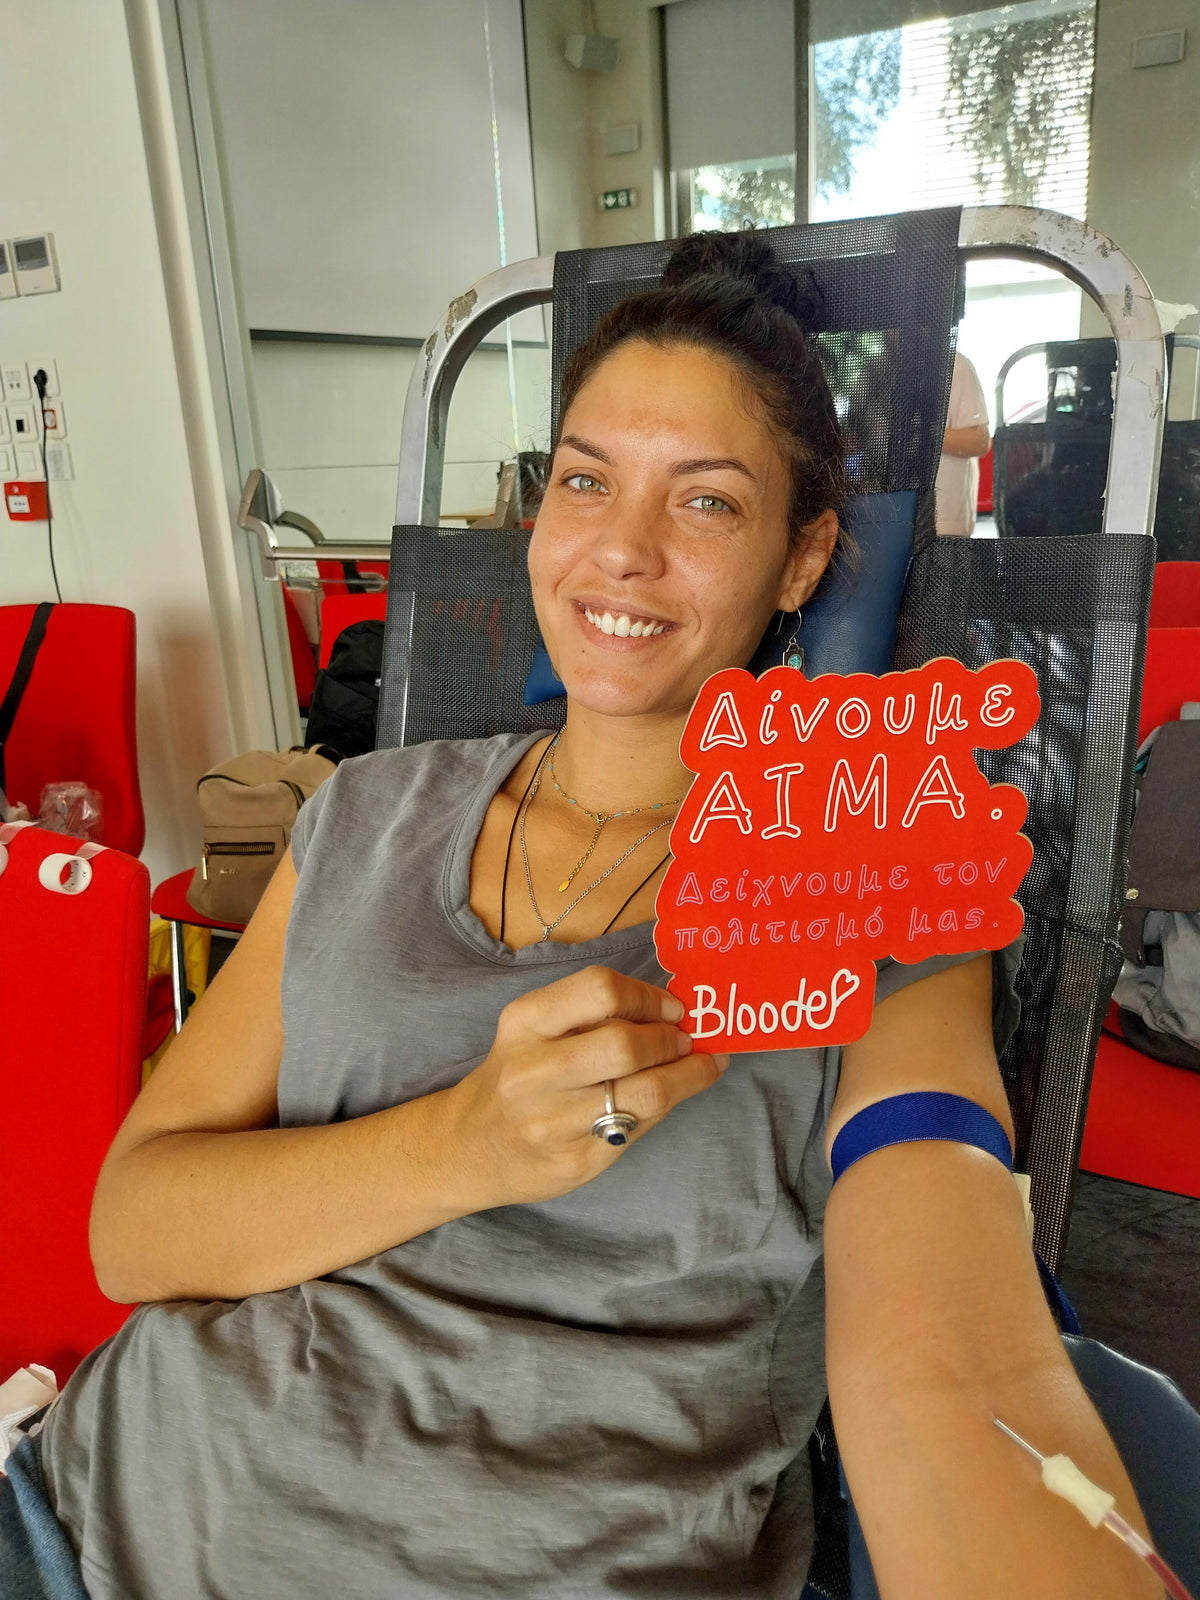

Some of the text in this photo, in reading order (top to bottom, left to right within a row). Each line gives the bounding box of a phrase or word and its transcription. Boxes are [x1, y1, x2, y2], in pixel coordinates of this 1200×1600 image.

[699, 682, 1015, 751] Δίνουμε
[689, 753, 1003, 844] ΑΙΜΑ.
[675, 857, 1007, 908] Δείχνουμε τον
[675, 906, 999, 953] πολιτισμό μας.
